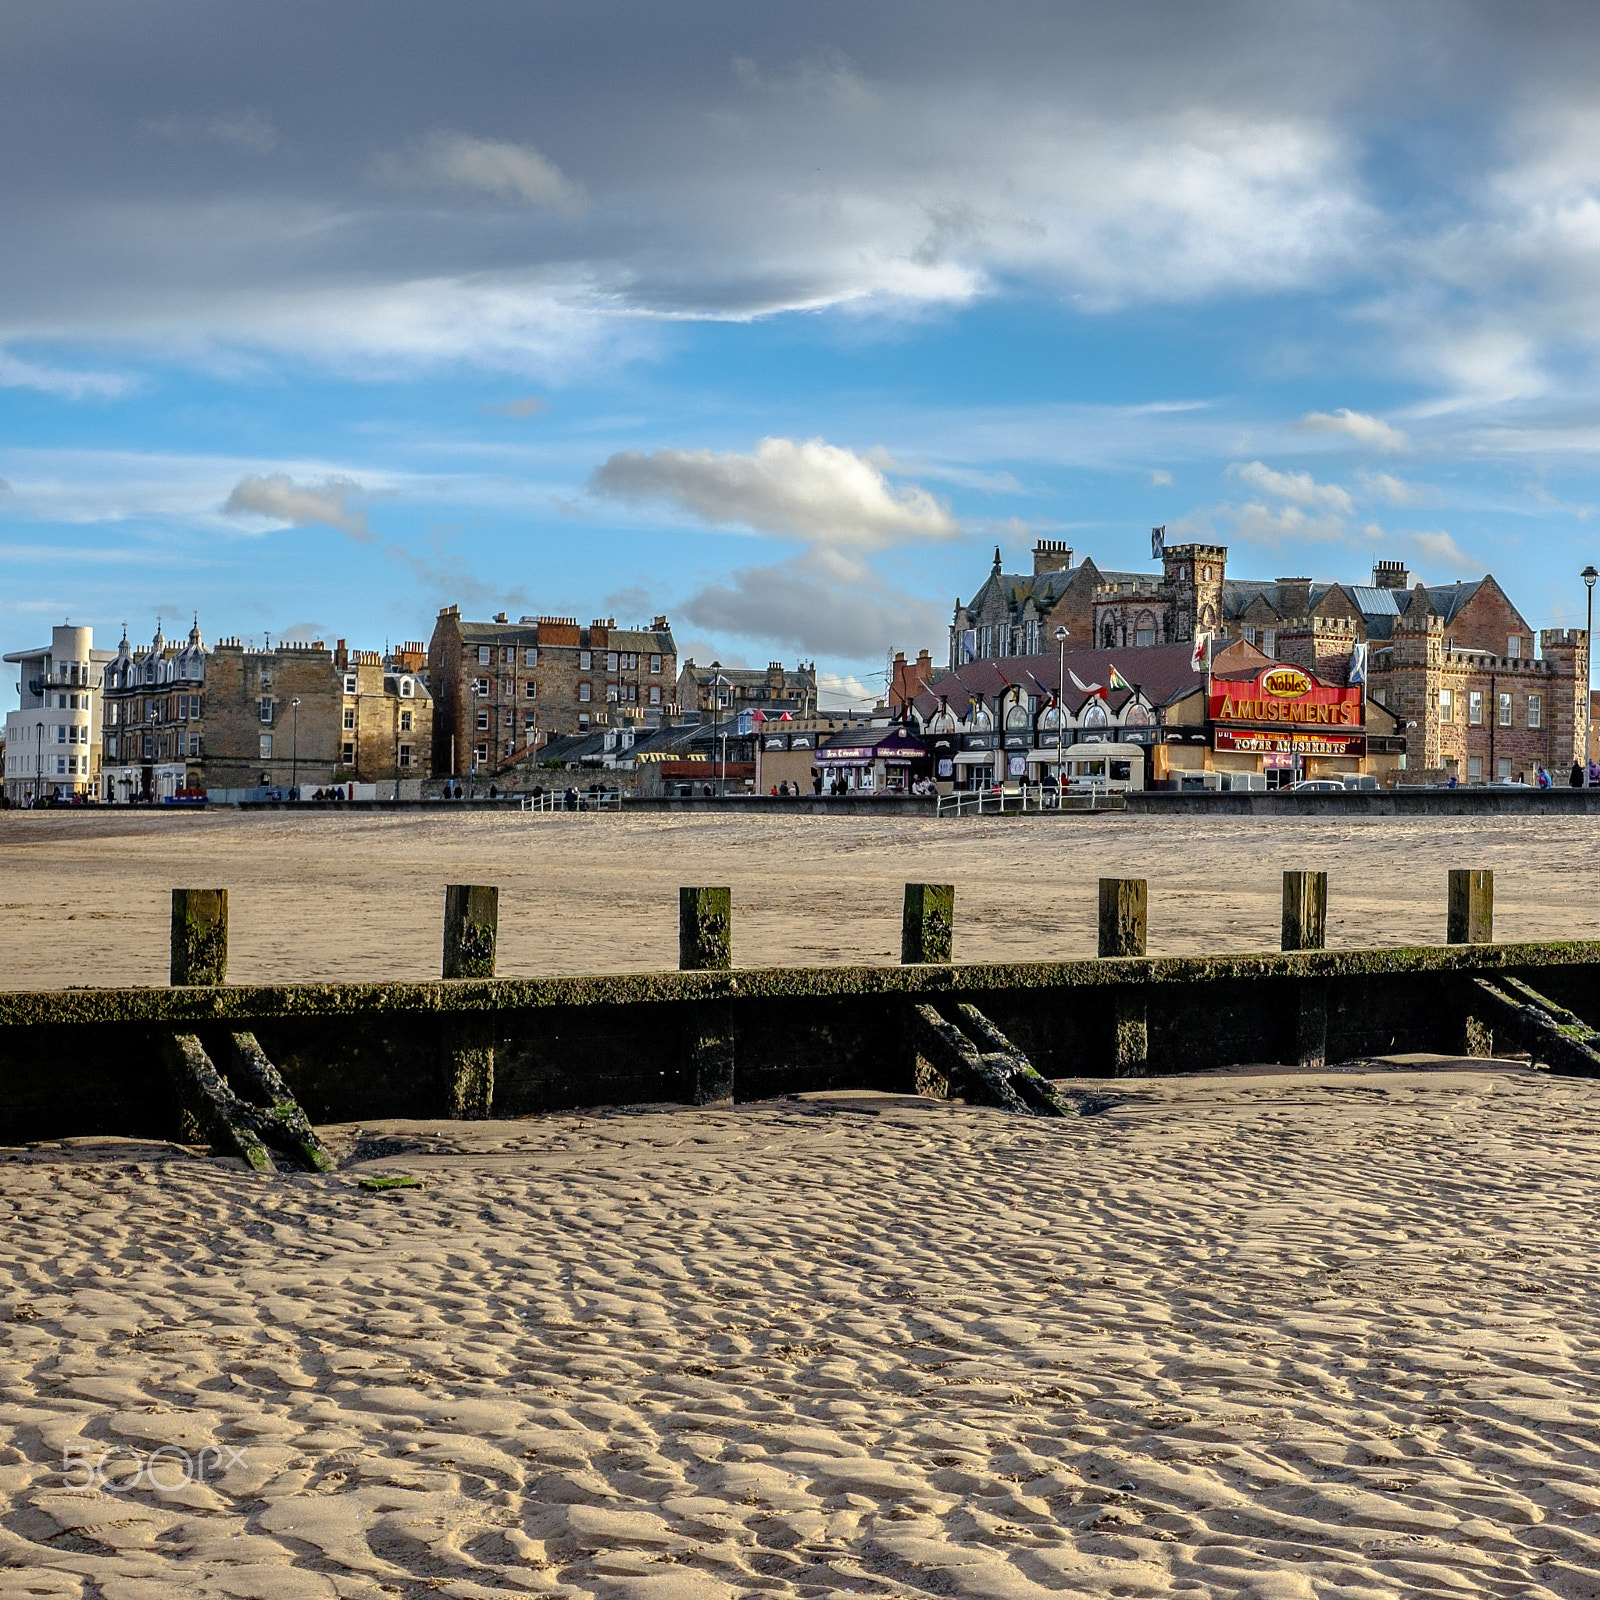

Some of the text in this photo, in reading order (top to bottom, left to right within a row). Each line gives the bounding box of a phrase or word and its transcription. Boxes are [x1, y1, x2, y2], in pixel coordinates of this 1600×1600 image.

[1266, 674, 1307, 692] Nobles
[1220, 694, 1353, 724] AMUSEMENTS
[1234, 738, 1271, 751] TOWER
[1275, 740, 1346, 754] AMUSEMENTS
